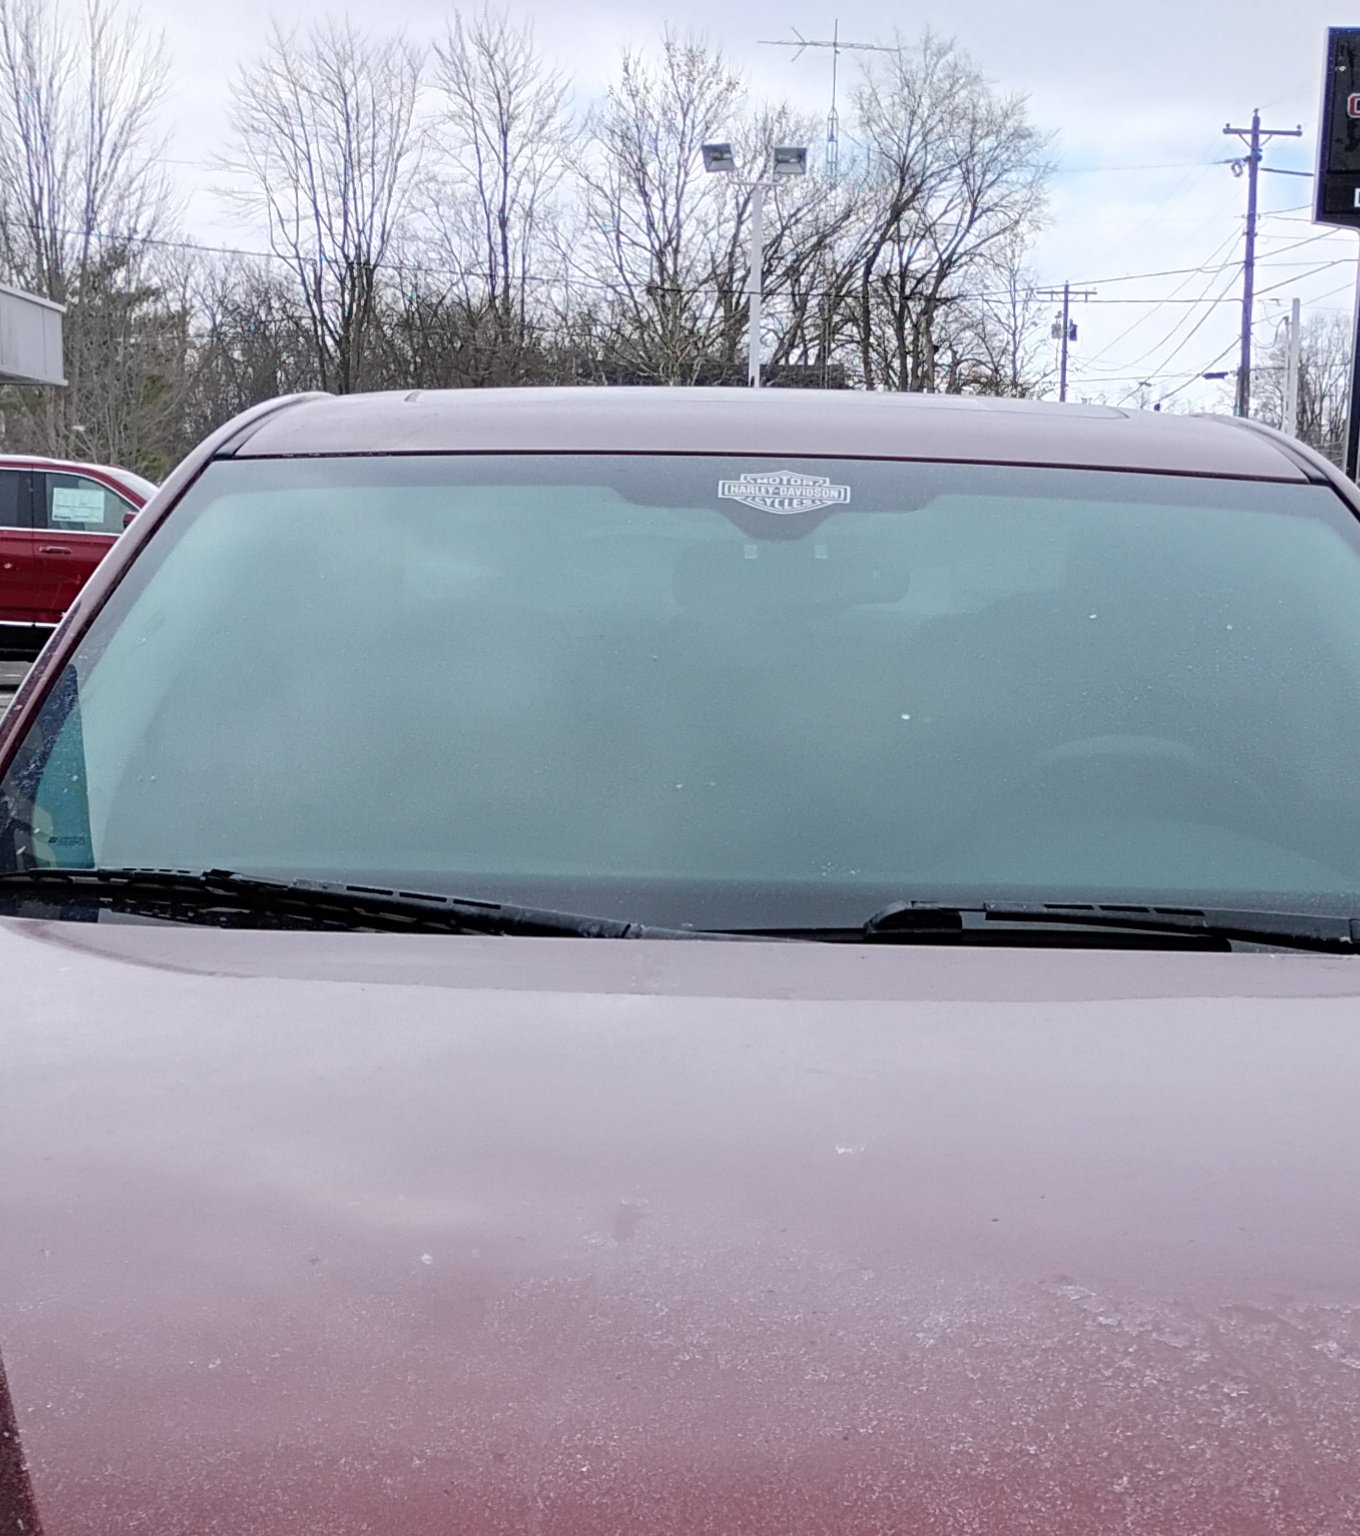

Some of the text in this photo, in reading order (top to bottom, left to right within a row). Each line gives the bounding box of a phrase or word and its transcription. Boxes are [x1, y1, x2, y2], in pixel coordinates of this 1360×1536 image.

[756, 475, 814, 486] MOTOR
[730, 483, 838, 499] HARLEY-DAVIDSON
[754, 497, 814, 509] CYCLES
